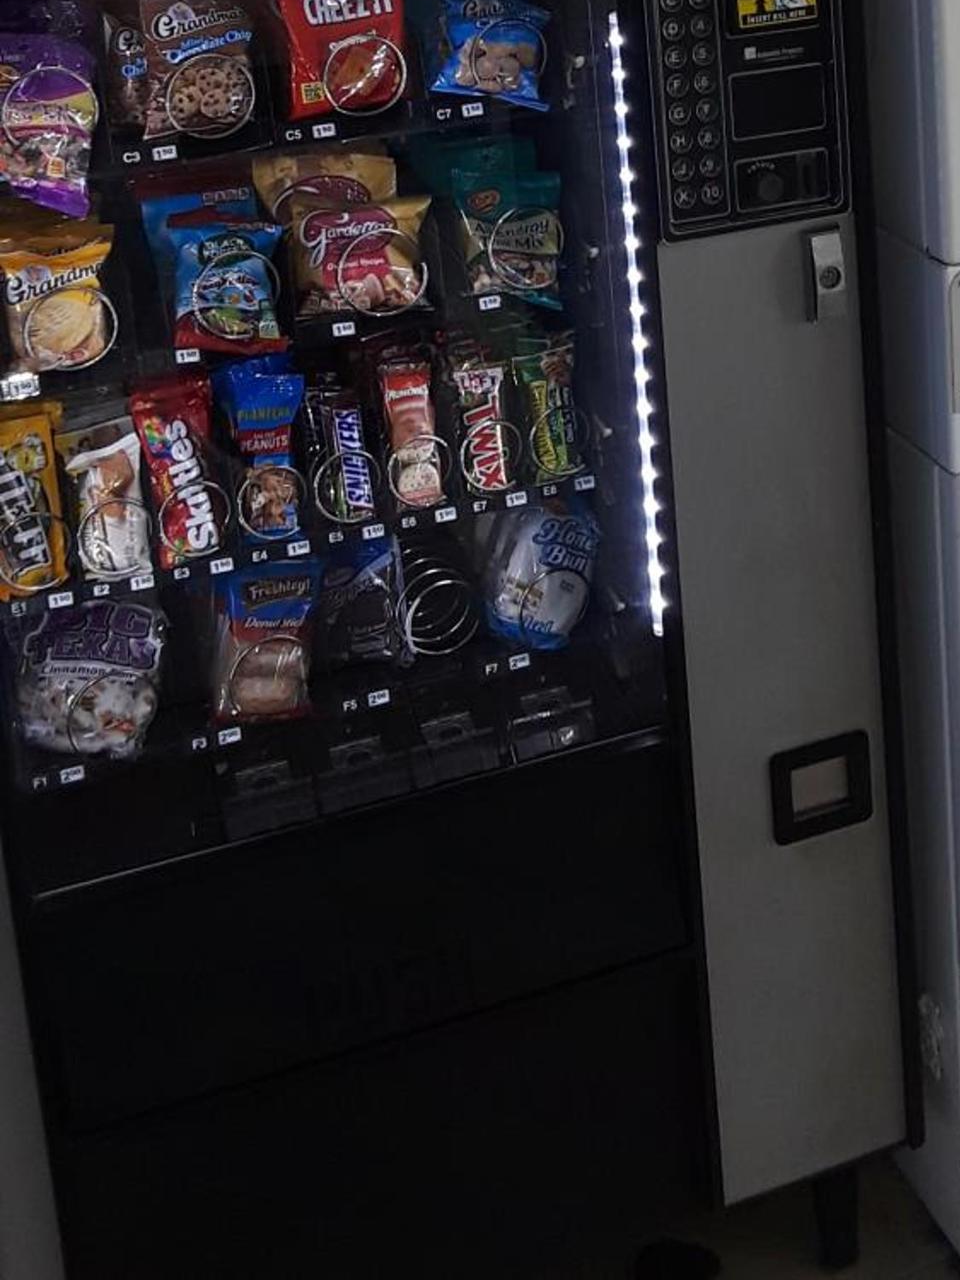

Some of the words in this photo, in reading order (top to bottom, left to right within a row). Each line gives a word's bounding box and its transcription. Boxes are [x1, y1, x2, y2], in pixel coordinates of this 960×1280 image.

[437, 109, 451, 120] C7
[286, 130, 301, 140] C5
[240, 435, 289, 451] PEANUTS
[464, 391, 505, 488] TWIX
[165, 420, 219, 550] Skittles
[474, 501, 487, 512] E7
[252, 552, 268, 562] E4
[542, 544, 587, 571] Bun
[343, 701, 357, 711] F5
